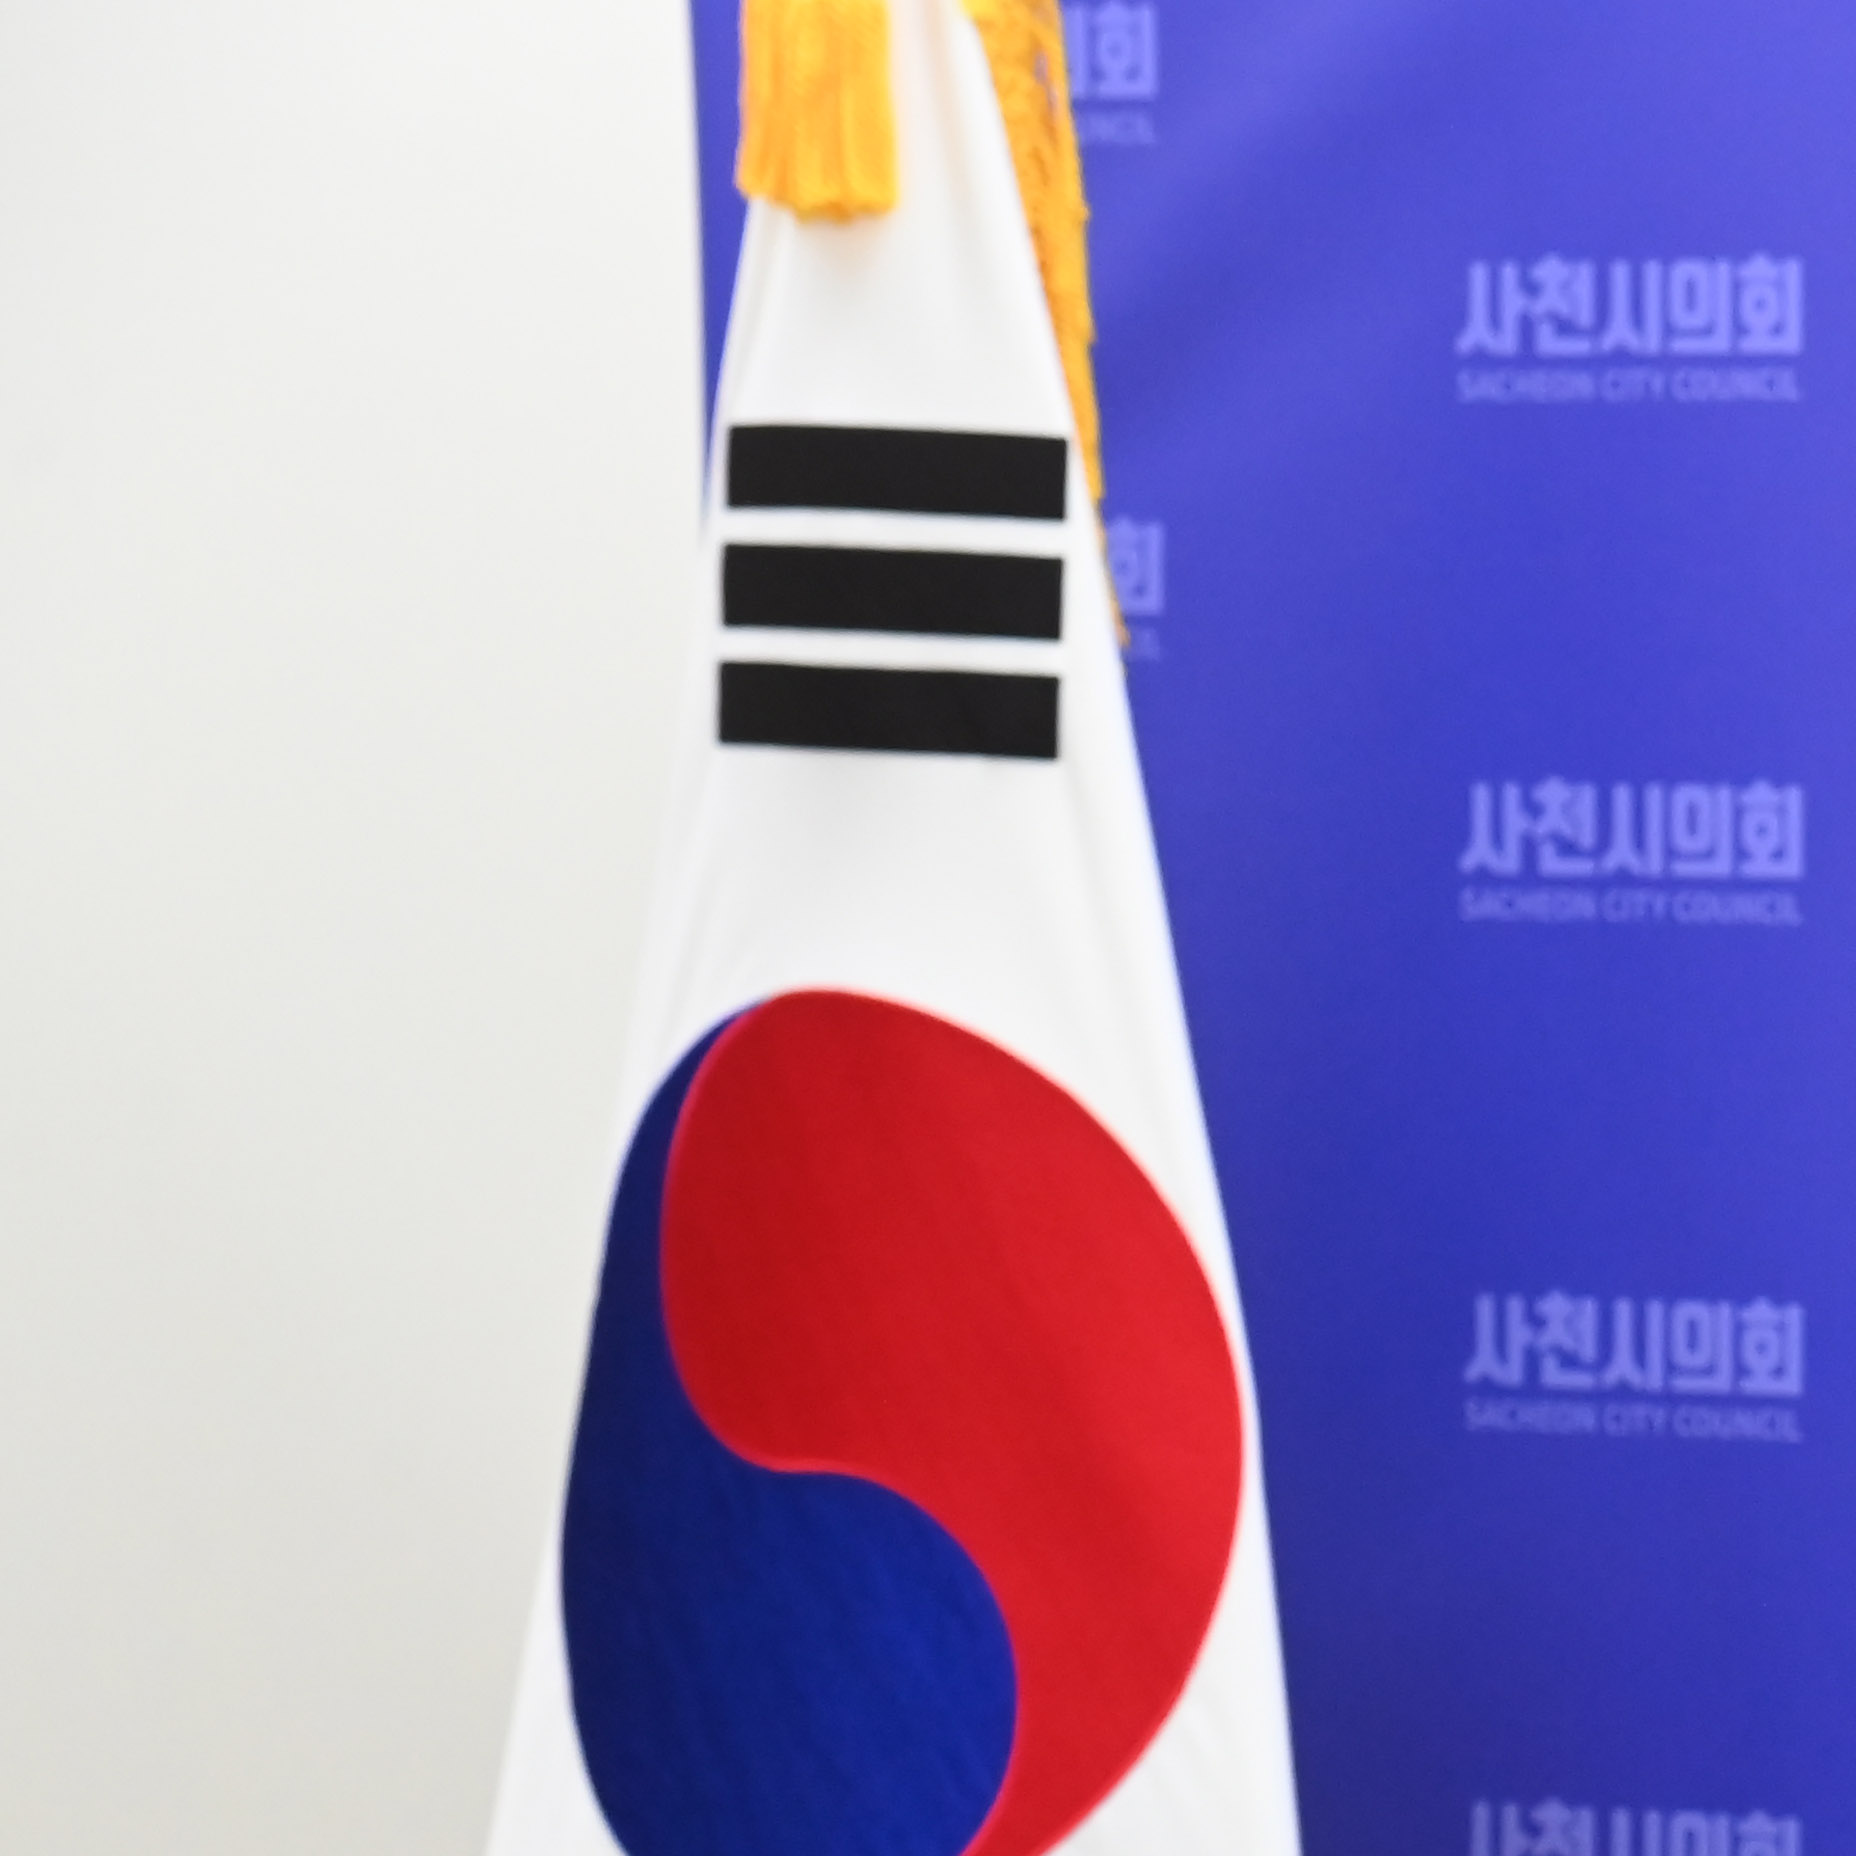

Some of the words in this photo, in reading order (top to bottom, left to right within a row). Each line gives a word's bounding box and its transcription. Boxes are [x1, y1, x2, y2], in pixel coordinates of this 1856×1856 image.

[1455, 254, 1803, 356] 사천시의회
[1459, 777, 1804, 879] 사천시의회
[1464, 1290, 1804, 1397] 사천시의회
